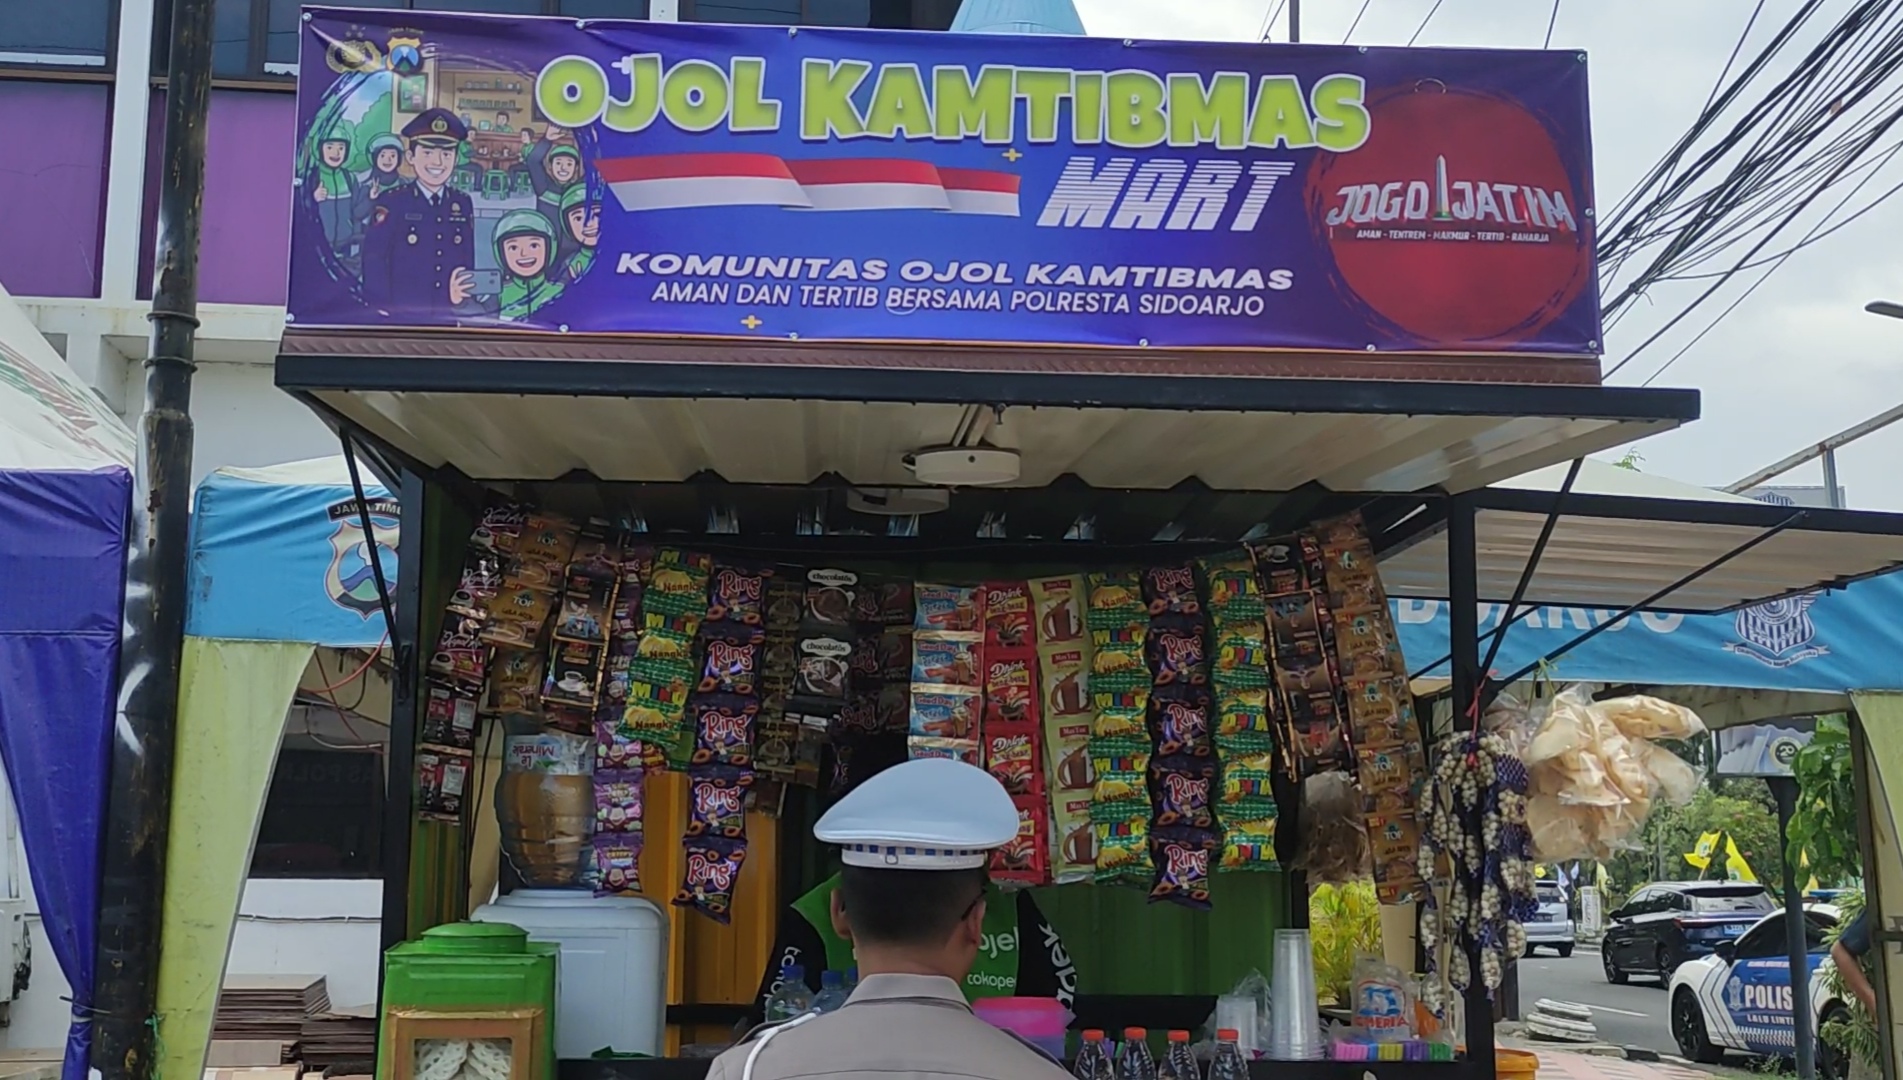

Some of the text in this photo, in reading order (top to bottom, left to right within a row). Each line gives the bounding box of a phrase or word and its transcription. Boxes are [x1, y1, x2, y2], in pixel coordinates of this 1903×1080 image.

[535, 53, 1370, 152] OJOL KAMTIBMAS
[1036, 156, 1296, 231] MART
[1326, 180, 1578, 232] JOGO JATIM
[1356, 229, 1382, 239] AMAN
[1388, 229, 1427, 240] TENTREM
[1433, 231, 1470, 241] MAKMUR
[1511, 232, 1550, 243] RAHARJA
[616, 252, 1295, 290] KOMUNITAS OJOL KAMTIBMAS
[651, 281, 1265, 317] AMAN DAN TERTIB BERSAMA POLRESTA SIDOARJO
[334, 502, 370, 515] JAW
[718, 570, 762, 600] Ring
[1150, 567, 1195, 592] Ring
[513, 596, 535, 607] TOP
[988, 587, 1022, 605] Drink
[708, 640, 753, 670] Ring
[1160, 633, 1202, 662] Ring
[990, 661, 1025, 679] Drink
[1362, 692, 1383, 701] TOP
[701, 711, 747, 741] Ring
[512, 745, 555, 757] Minerale
[992, 734, 1029, 753] Drink
[1374, 762, 1394, 772] TOP
[695, 783, 740, 812] Ring
[1166, 774, 1208, 805] Ring
[1384, 830, 1404, 840] TOP
[688, 855, 731, 890] Ring
[1164, 845, 1208, 875] Ring
[1747, 1014, 1770, 1023] LALU
